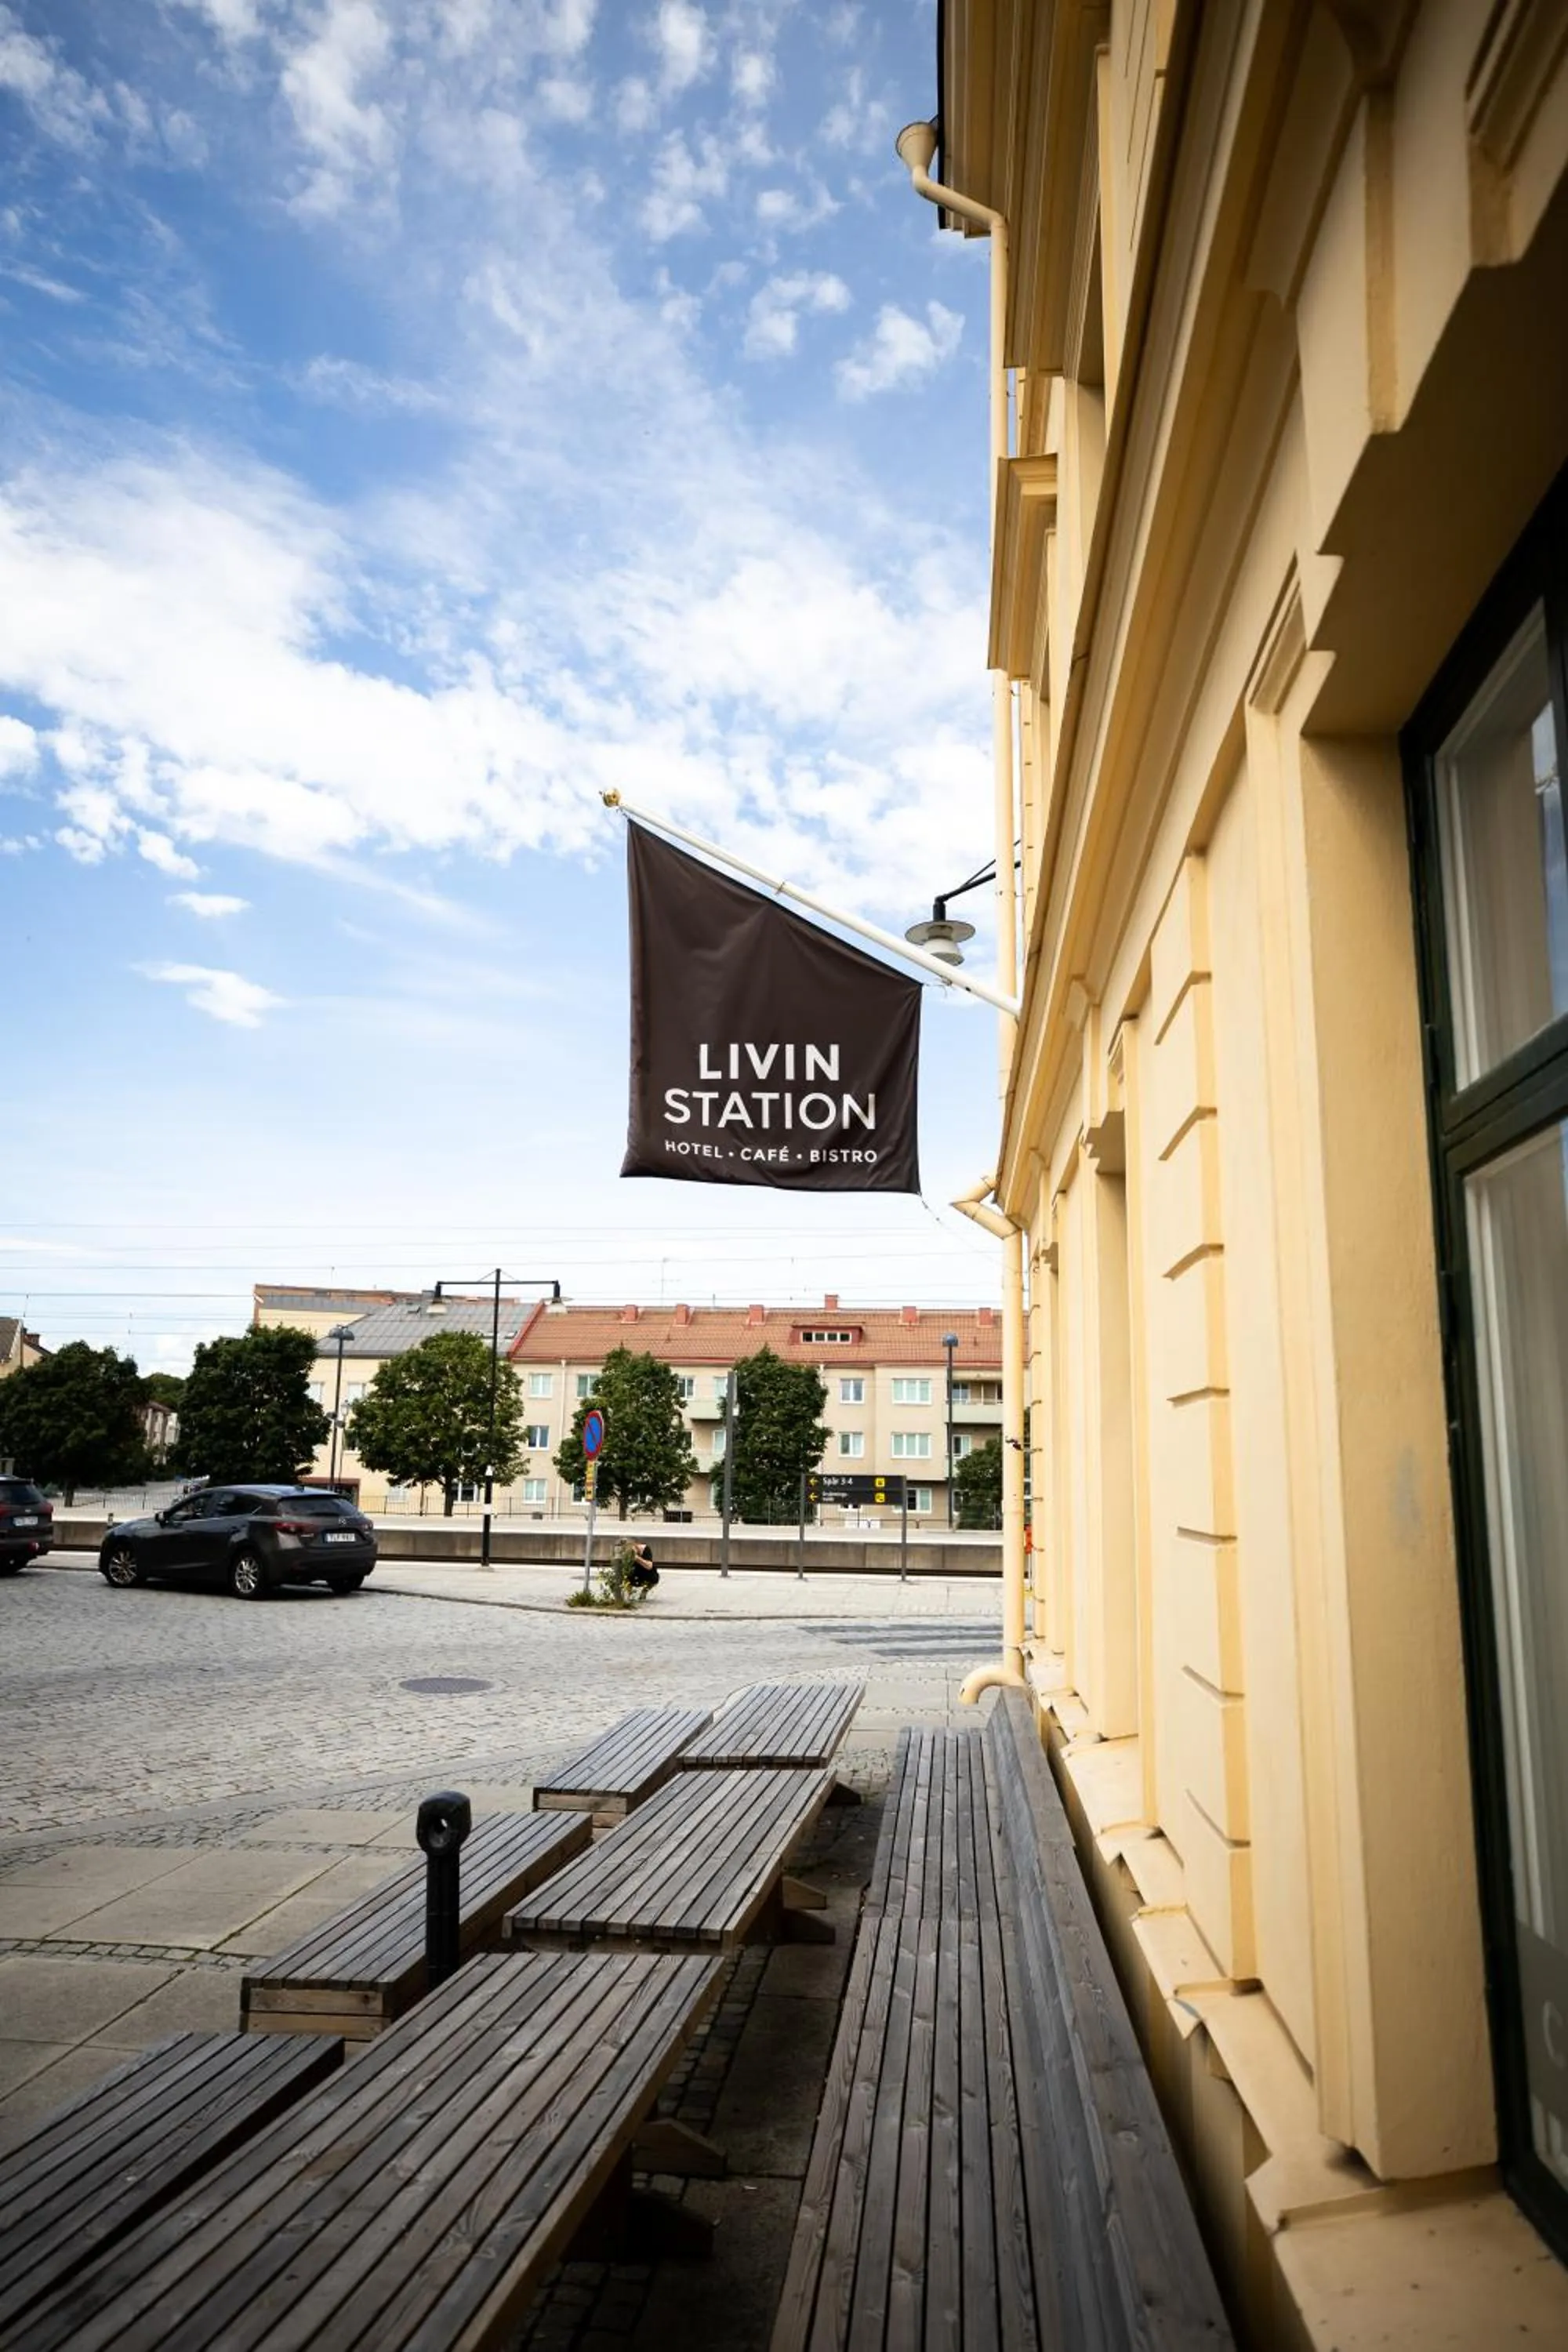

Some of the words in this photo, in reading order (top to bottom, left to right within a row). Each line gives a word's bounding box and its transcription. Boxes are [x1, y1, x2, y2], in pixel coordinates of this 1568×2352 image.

[699, 1042, 840, 1081] LIVIN
[663, 1087, 876, 1130] STATION
[664, 1139, 724, 1159] HOTEL
[740, 1145, 789, 1163] CAFÉ
[810, 1149, 878, 1163] BISTRO
